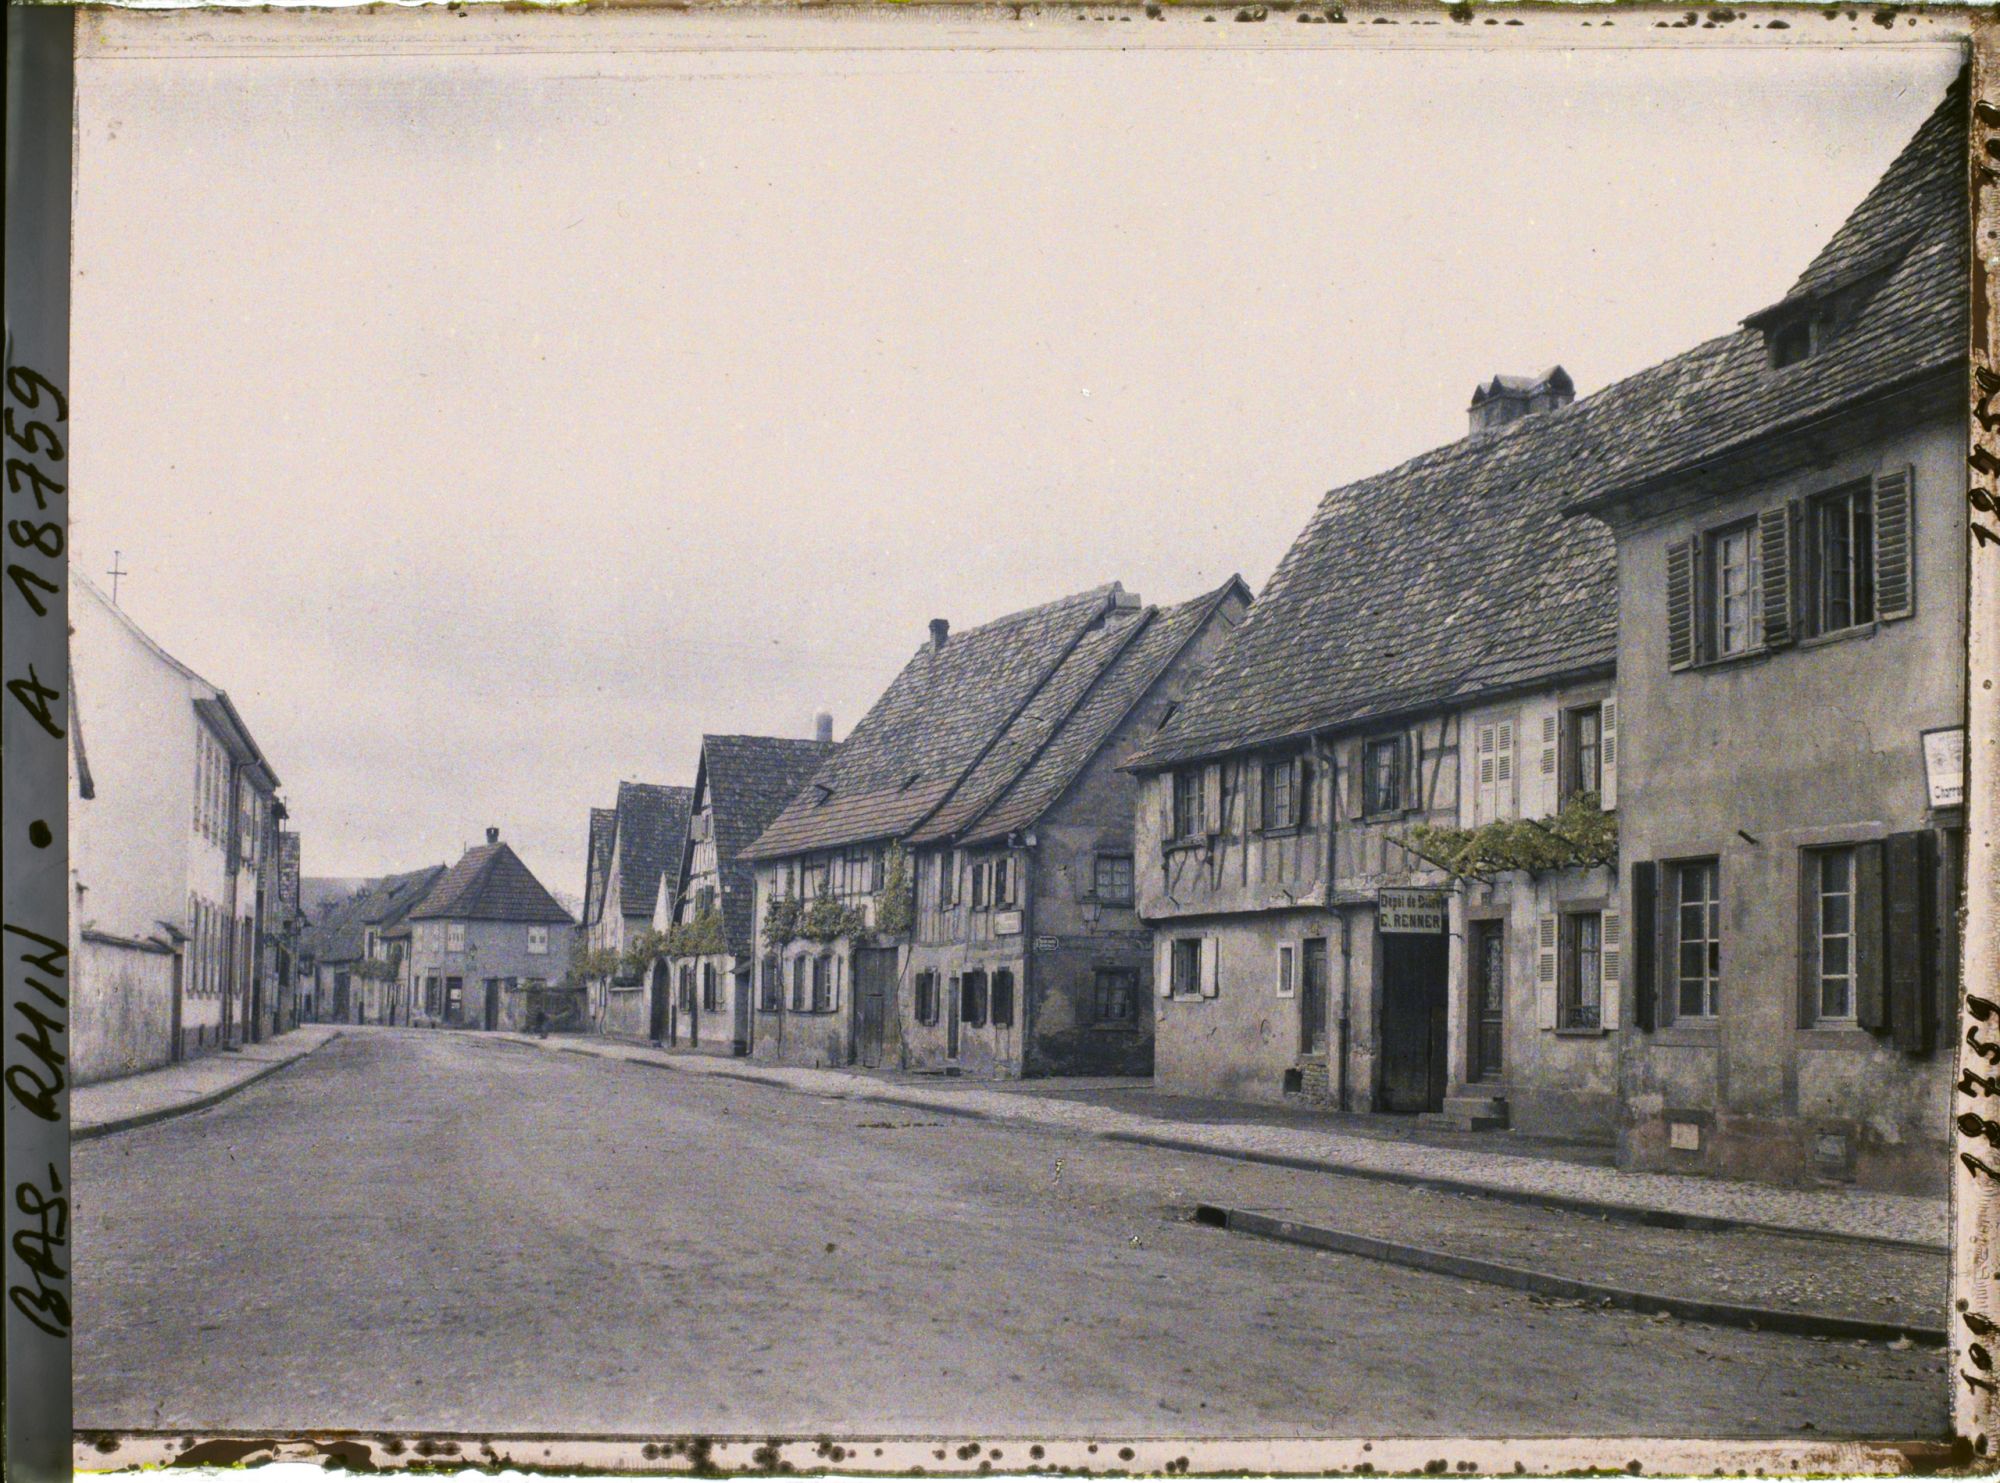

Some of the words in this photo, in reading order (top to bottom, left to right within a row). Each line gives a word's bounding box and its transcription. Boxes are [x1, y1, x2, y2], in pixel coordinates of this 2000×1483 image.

[4, 366, 68, 617] 18759
[6, 664, 66, 740] A
[1394, 913, 1440, 929] RENNER
